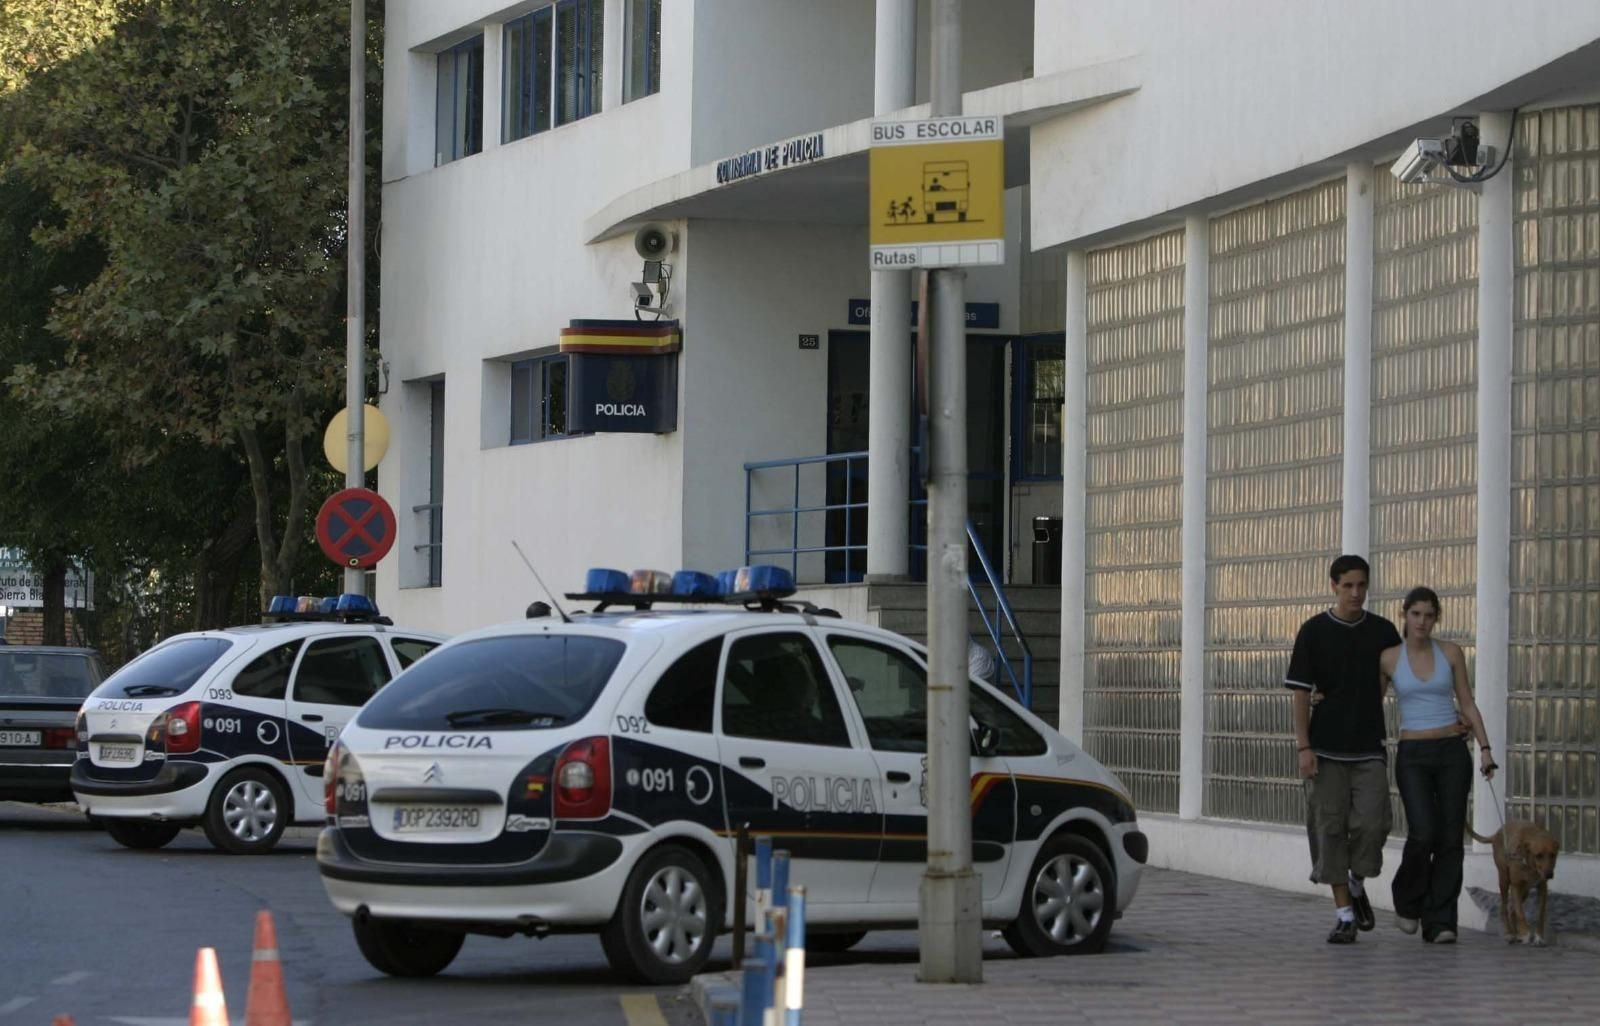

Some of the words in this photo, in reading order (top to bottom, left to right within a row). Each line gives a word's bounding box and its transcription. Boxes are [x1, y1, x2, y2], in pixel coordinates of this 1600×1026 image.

[873, 125, 905, 140] BUS
[917, 120, 995, 137] ESCOLAR
[764, 145, 780, 170] DE
[782, 134, 824, 166] POLICIA
[873, 251, 917, 265] Rutas
[802, 337, 816, 347] 25
[595, 403, 647, 416] POLICIA
[18, 573, 31, 587] de
[0, 588, 26, 600] Sierra
[209, 688, 233, 700] D93
[98, 701, 143, 711] POLICIA
[215, 718, 242, 734] 091
[617, 715, 651, 734] D92
[384, 735, 493, 750] POLICIA
[642, 768, 674, 792] 091
[344, 783, 366, 802] 091
[770, 776, 878, 814] POLICIA
